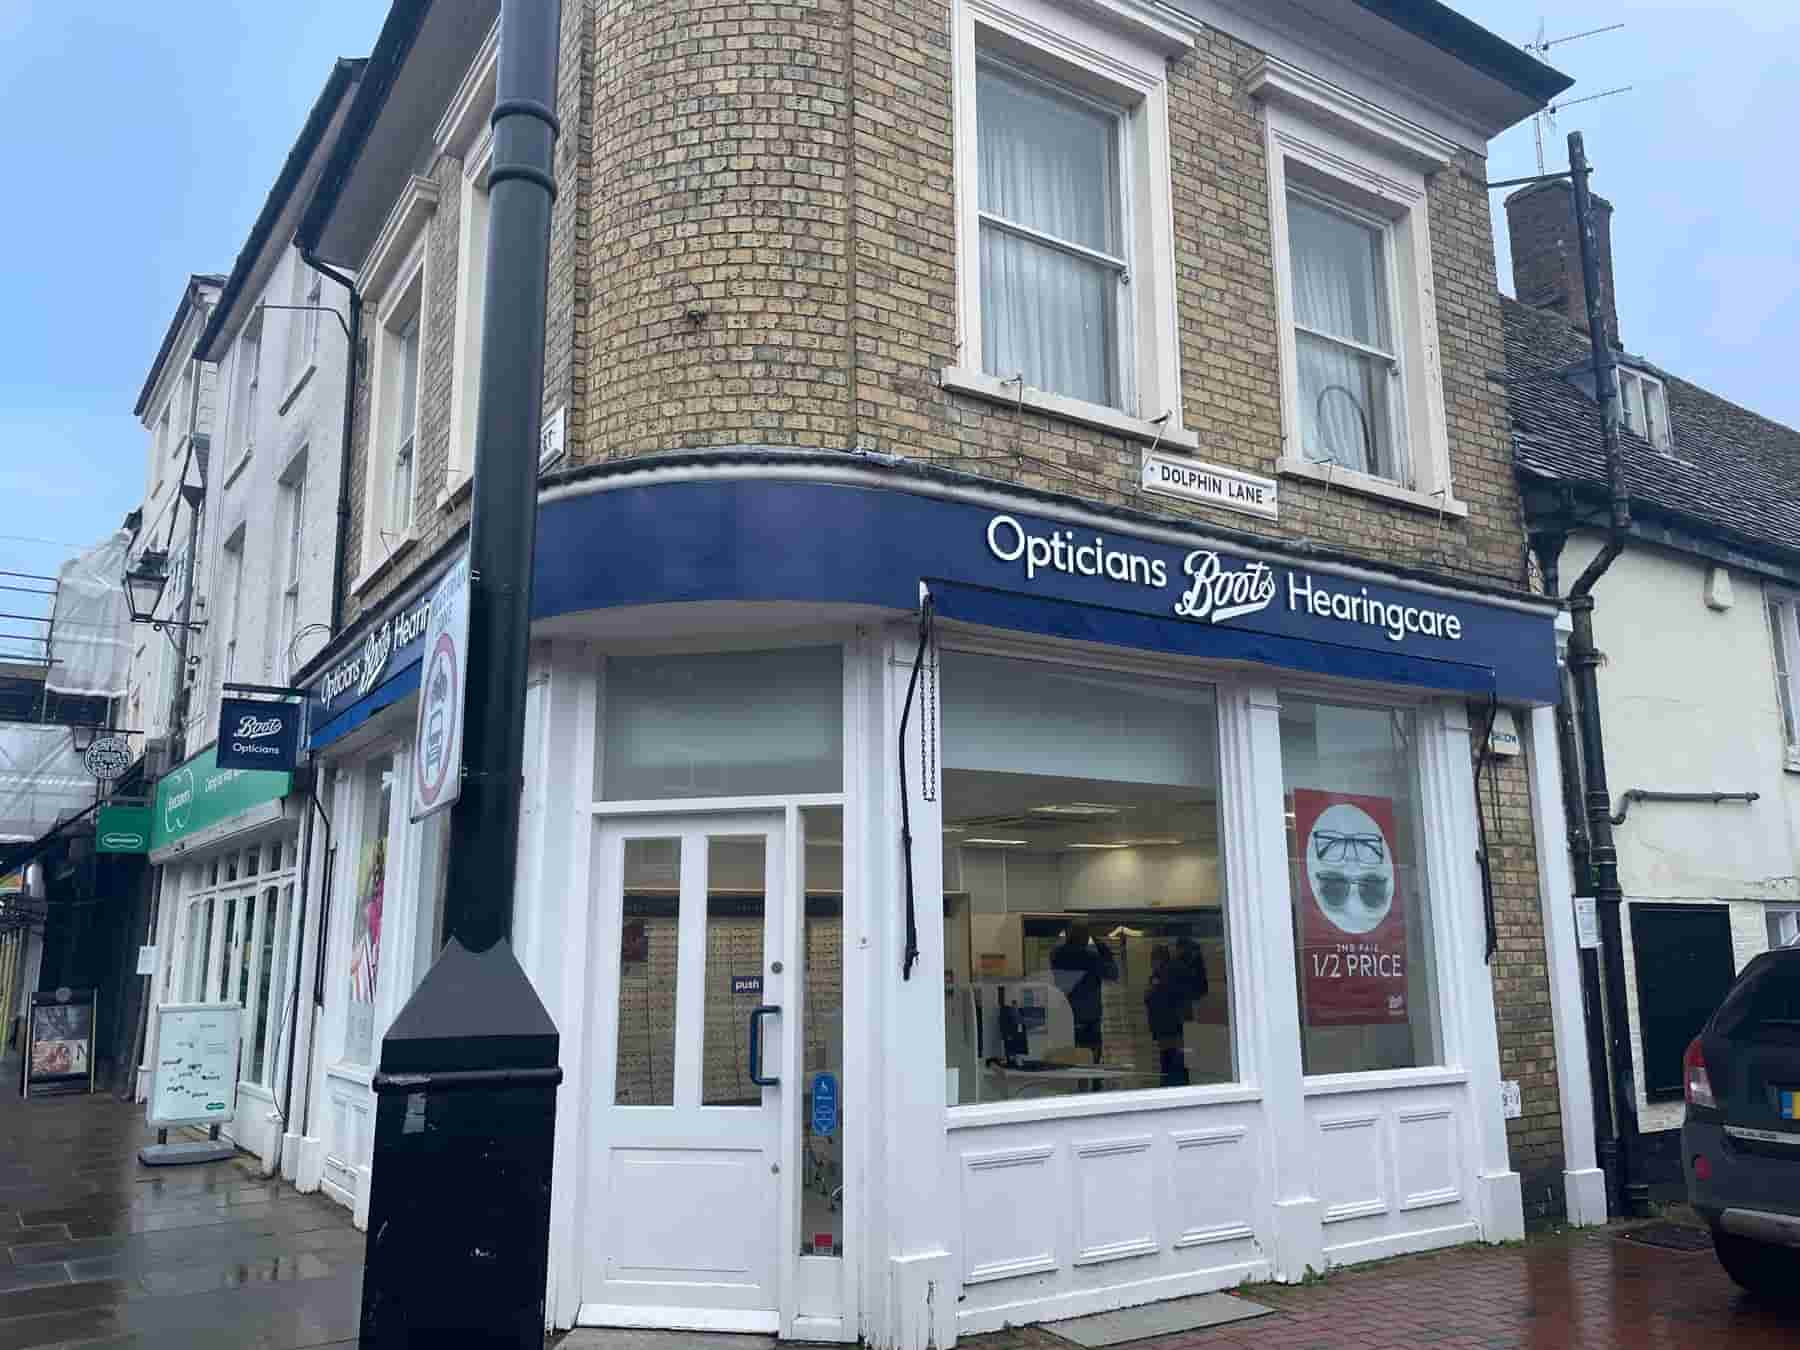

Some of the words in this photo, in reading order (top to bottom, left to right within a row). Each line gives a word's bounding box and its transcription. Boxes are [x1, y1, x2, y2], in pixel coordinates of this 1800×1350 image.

[1160, 464, 1223, 495] DOLPHIN
[1228, 479, 1264, 504] LANE
[986, 515, 1168, 588] Opticians
[1174, 550, 1276, 623] Boots
[1288, 572, 1462, 641] Hearingcare
[320, 660, 360, 712] Opticians
[233, 715, 282, 739] Boots
[232, 742, 280, 755] Opticians
[1312, 953, 1342, 978] 1/2
[1346, 953, 1403, 977] PRICE
[735, 979, 760, 991] push
